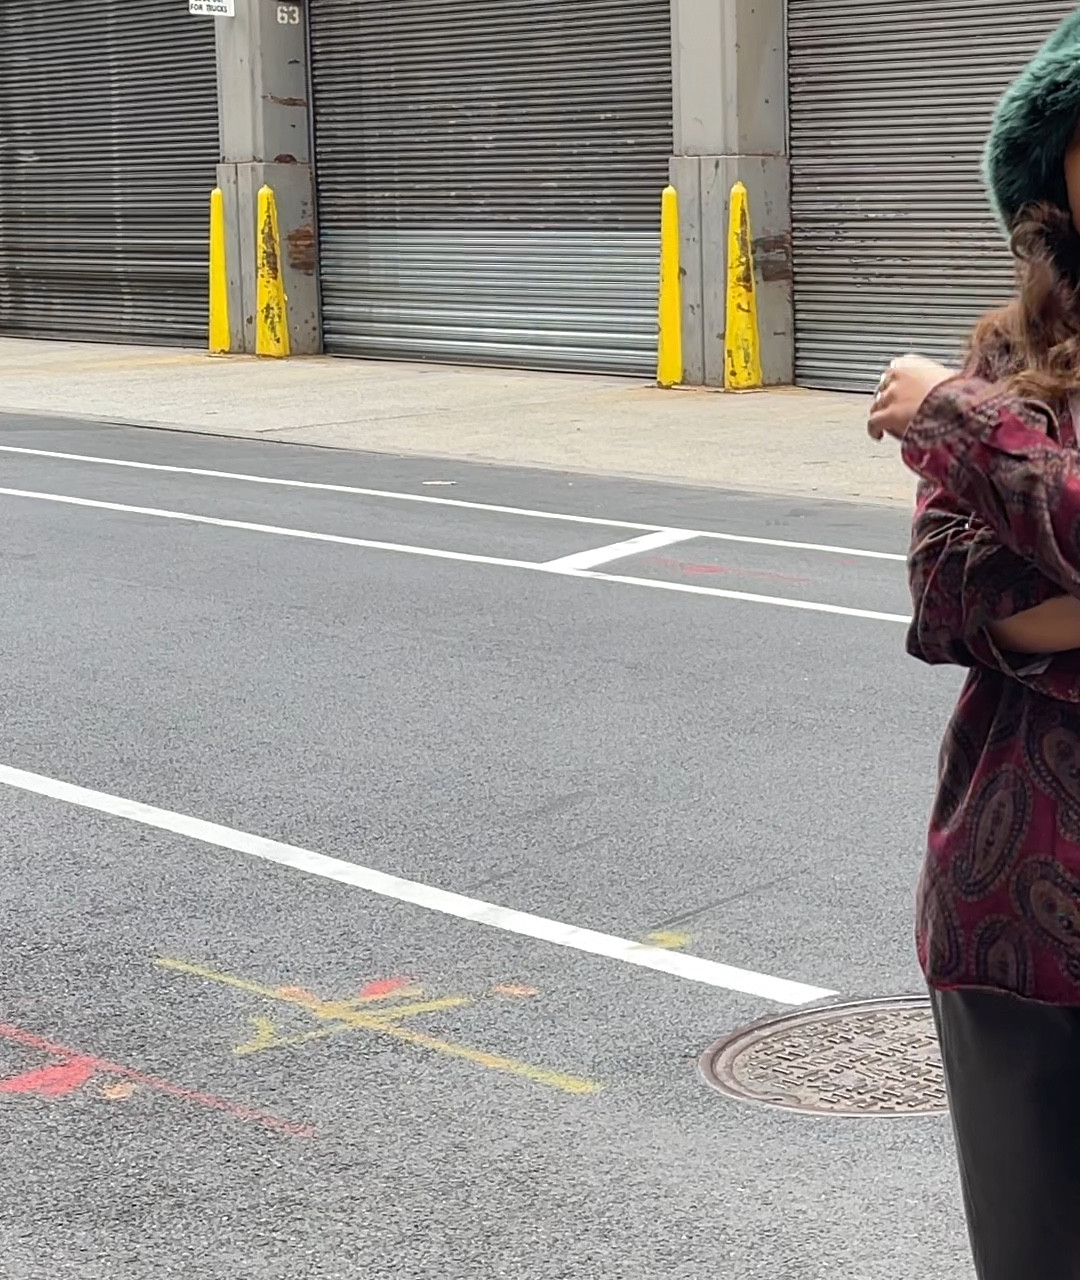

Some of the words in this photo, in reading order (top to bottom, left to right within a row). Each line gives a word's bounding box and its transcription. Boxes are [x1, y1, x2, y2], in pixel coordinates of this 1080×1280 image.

[190, 3, 203, 11] FOR
[206, 4, 227, 13] TRUCKS
[276, 6, 299, 24] 63
